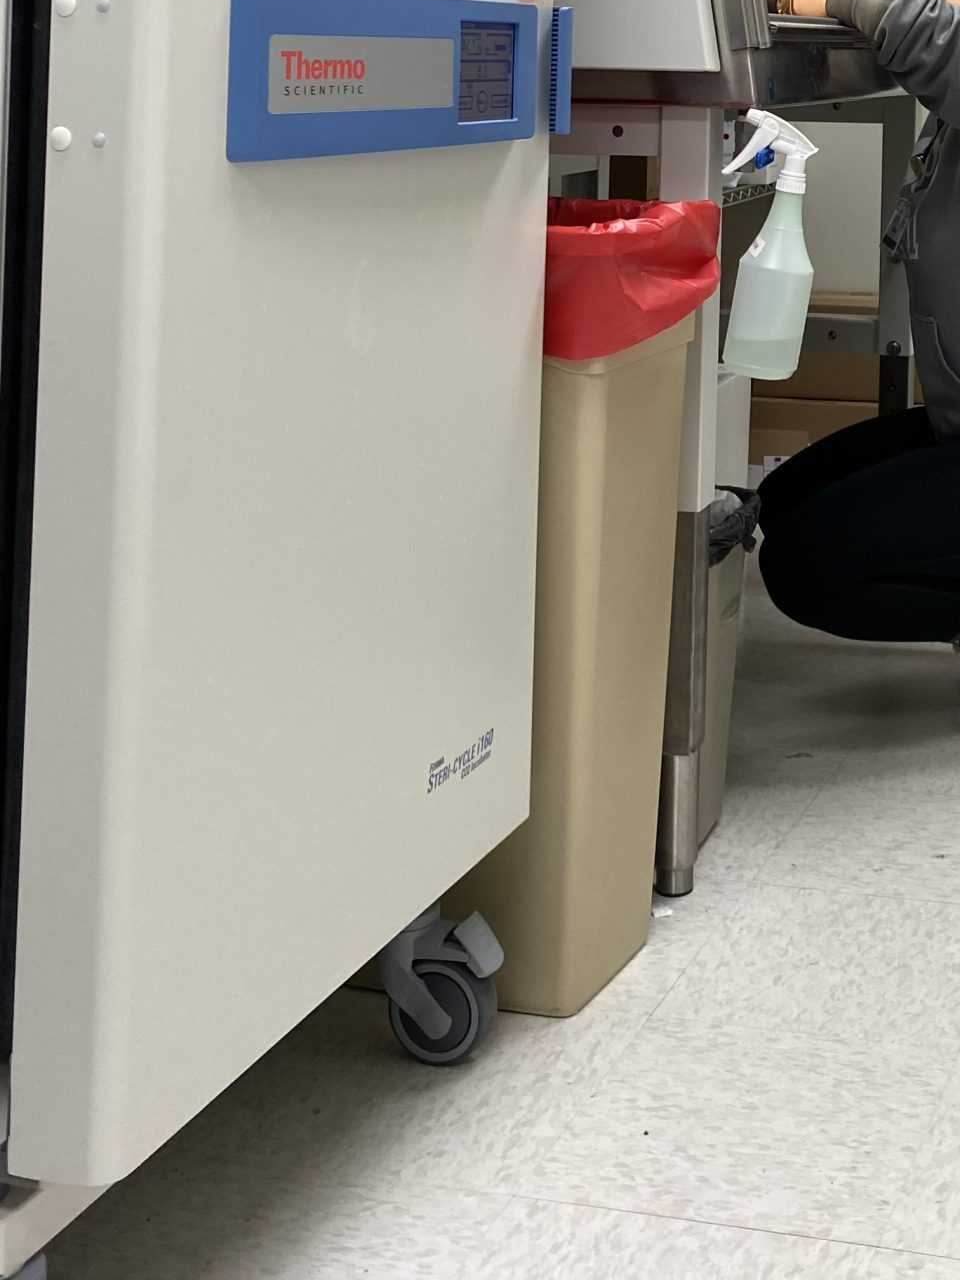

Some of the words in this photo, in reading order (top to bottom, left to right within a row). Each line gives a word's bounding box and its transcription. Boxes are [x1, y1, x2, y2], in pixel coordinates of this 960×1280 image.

[281, 50, 366, 80] Thermo
[284, 85, 364, 96] SCIENTIFIC
[477, 727, 494, 755] i160
